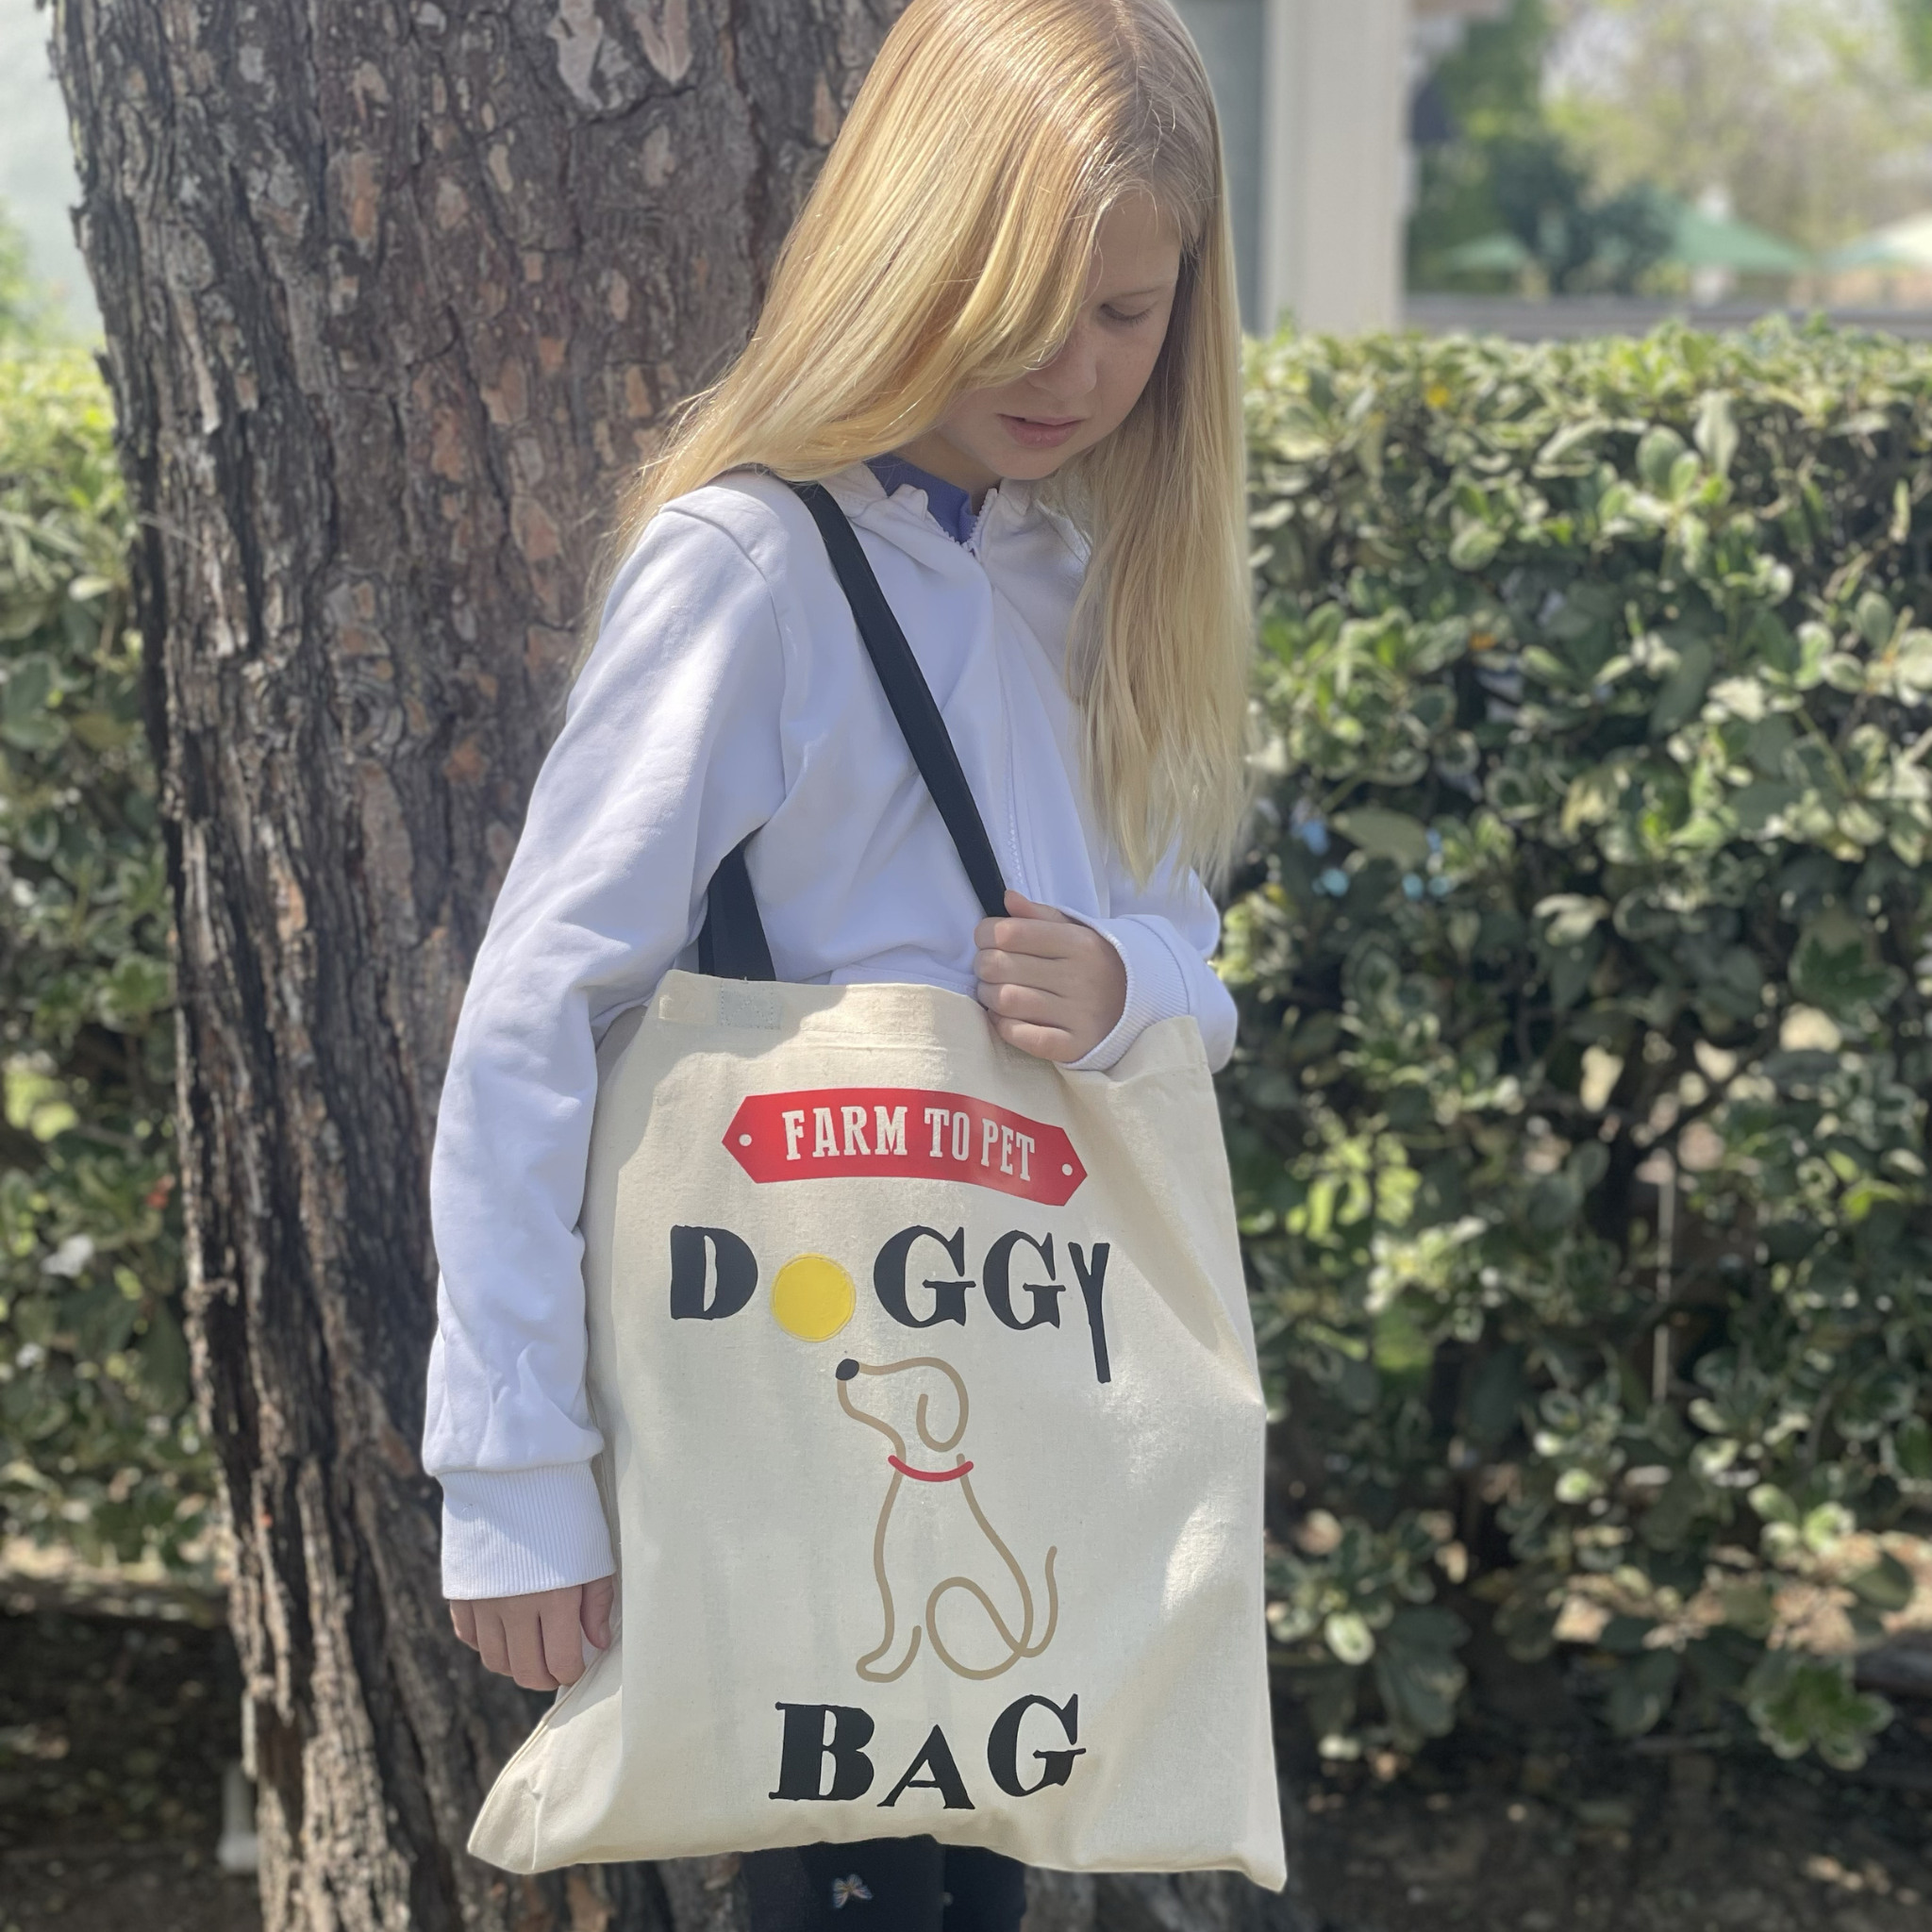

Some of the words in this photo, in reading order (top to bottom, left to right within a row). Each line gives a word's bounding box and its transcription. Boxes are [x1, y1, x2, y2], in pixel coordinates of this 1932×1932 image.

[781, 1105, 908, 1161] FARM
[924, 1107, 970, 1161] TO
[981, 1117, 1035, 1182] PET
[768, 1692, 1087, 1810] BAG
